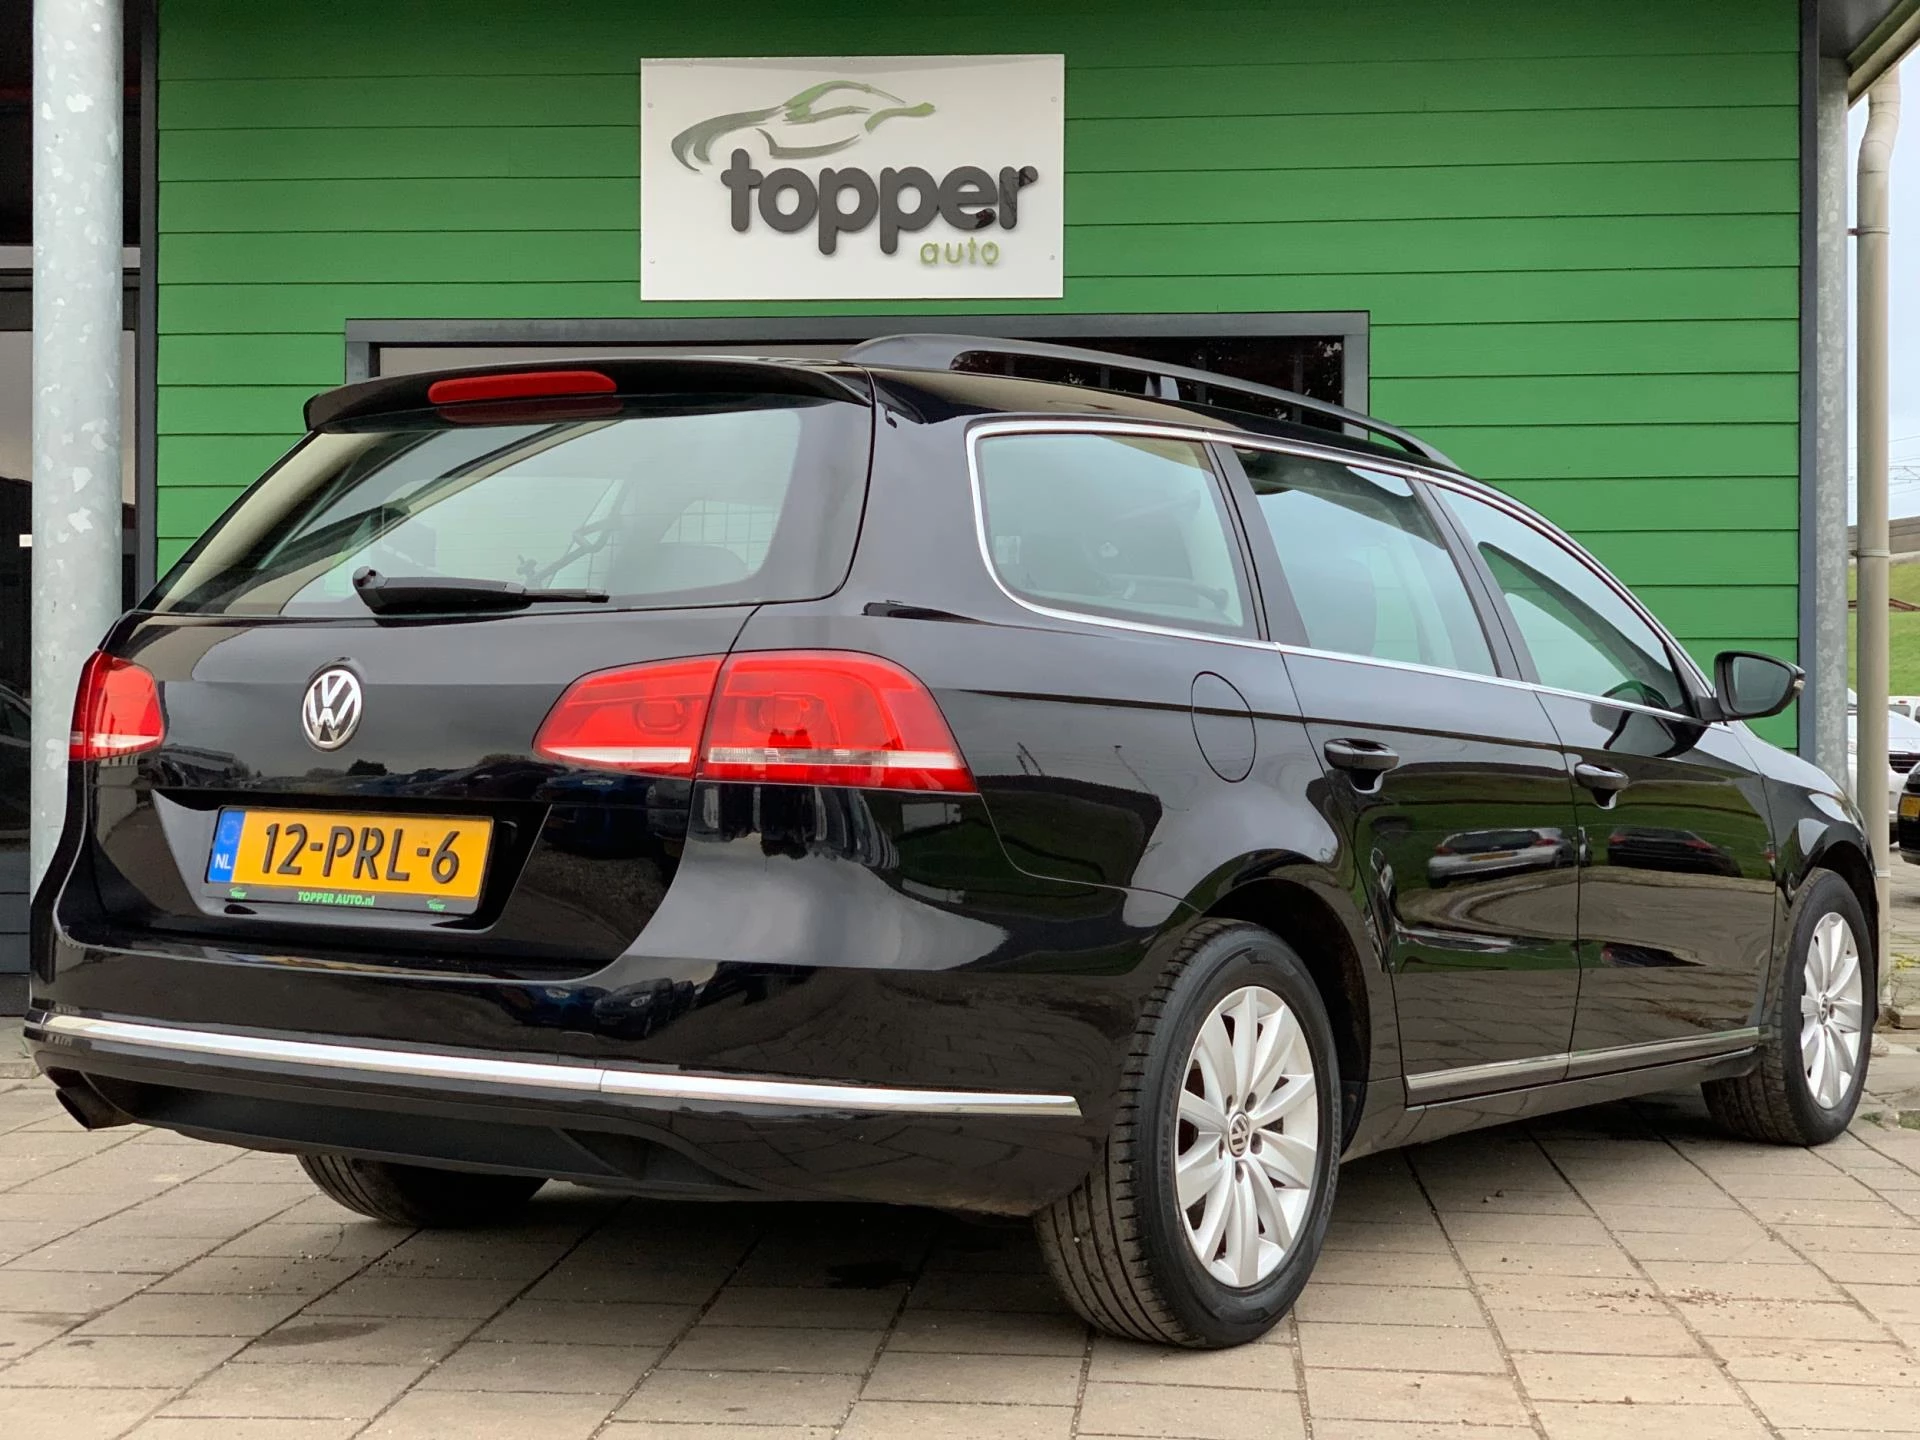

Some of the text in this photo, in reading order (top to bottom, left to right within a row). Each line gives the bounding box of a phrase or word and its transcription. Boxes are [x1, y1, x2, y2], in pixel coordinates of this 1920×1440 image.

[720, 148, 1039, 255] topper
[919, 237, 1000, 266] auto
[214, 853, 232, 870] NL
[262, 823, 460, 884] 12-PRL-6
[298, 891, 376, 907] TOPPER AUTO.nl
